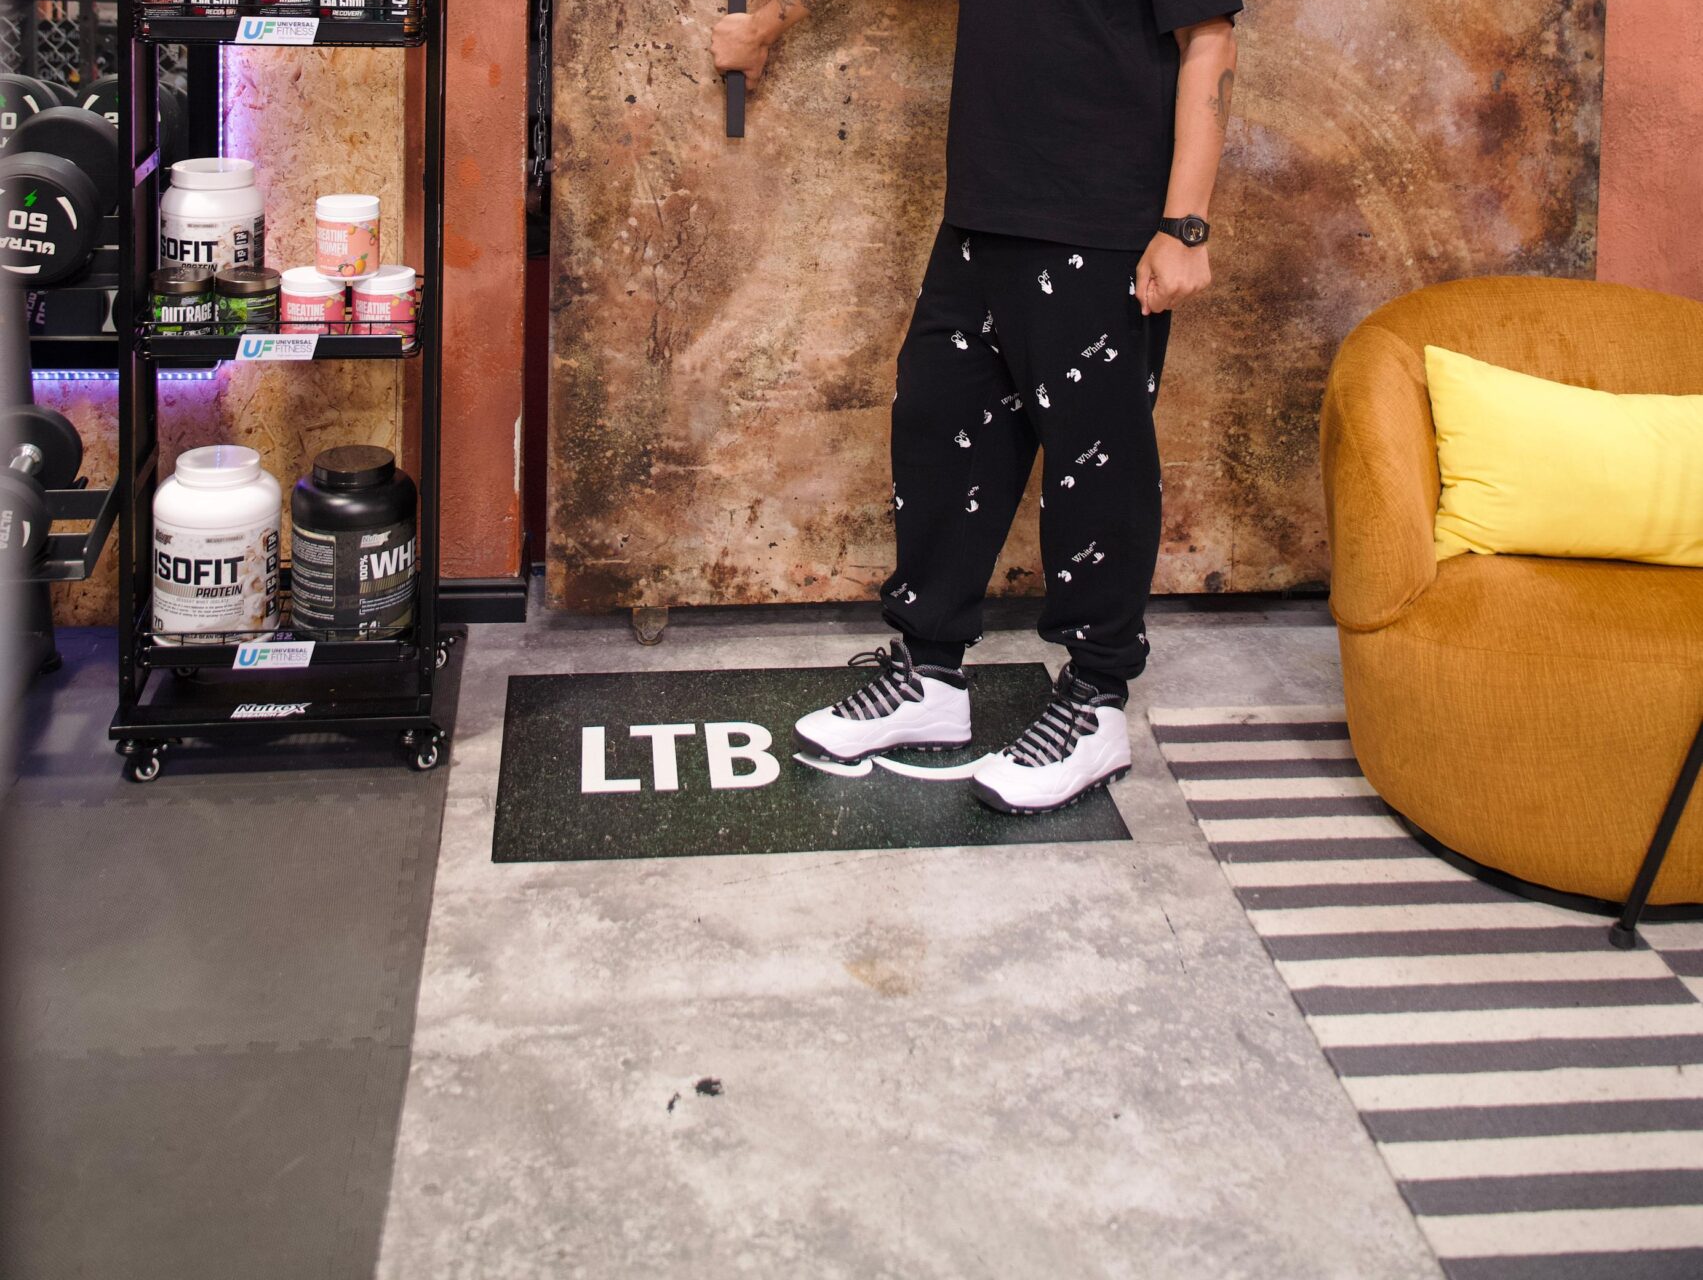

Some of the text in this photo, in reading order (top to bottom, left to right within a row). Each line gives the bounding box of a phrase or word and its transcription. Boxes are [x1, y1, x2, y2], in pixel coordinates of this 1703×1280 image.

[277, 27, 315, 36] FITNESS
[8, 209, 48, 233] 50
[162, 302, 213, 322] OUTRAGE
[287, 302, 325, 317] CREATINE
[155, 549, 244, 585] ISOFIT
[360, 555, 368, 580] 100%
[196, 584, 243, 598] PROTEIN
[234, 702, 312, 718] Nutrex
[581, 722, 781, 793] LTB
